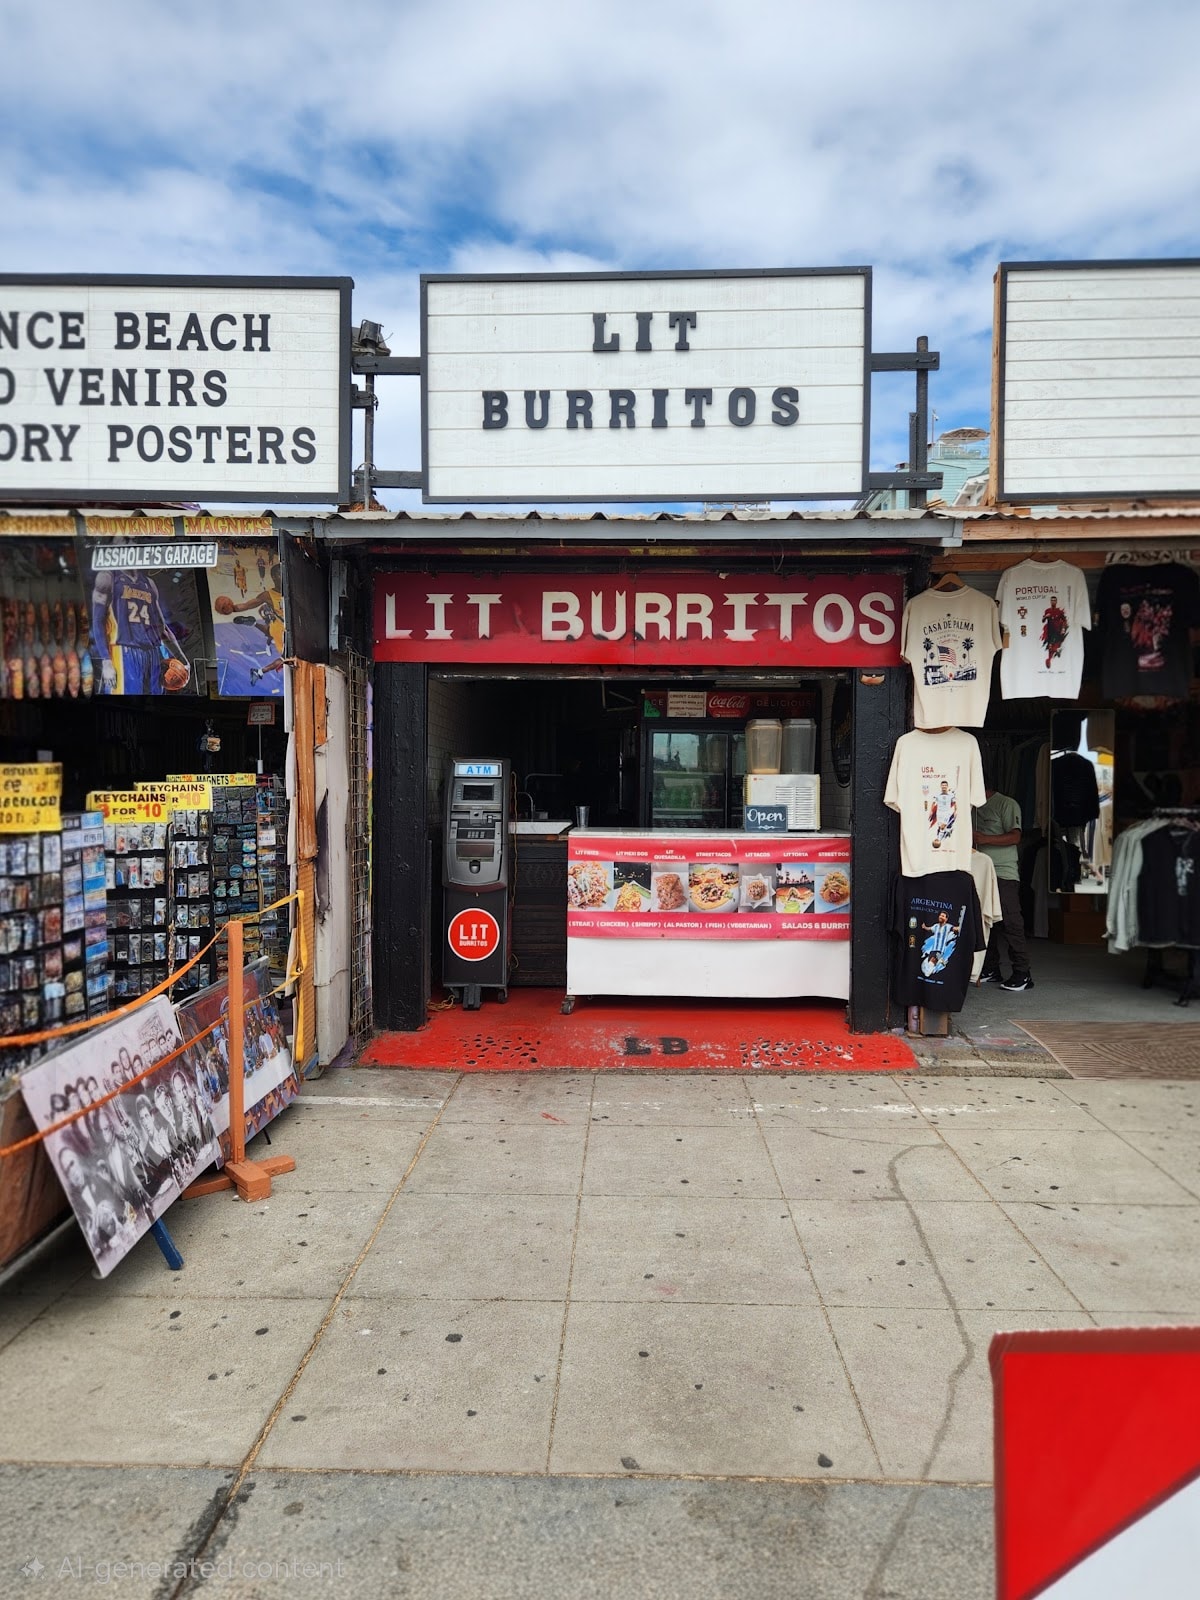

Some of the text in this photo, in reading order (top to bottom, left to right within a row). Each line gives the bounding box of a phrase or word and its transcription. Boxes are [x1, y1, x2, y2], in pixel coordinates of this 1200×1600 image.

[115, 312, 271, 352] BEACH
[592, 312, 697, 352] LIT
[43, 367, 228, 407] VENIRS
[482, 387, 799, 429] BURRITOS
[0, 423, 317, 465] ORY POSTERS
[87, 516, 174, 535] SOUVENIRS
[185, 516, 272, 535] MAGNETS
[96, 544, 214, 567] ASSHOLE'S GARAGE
[1015, 585, 1059, 595] PORTUGAL
[128, 601, 150, 625] 24
[385, 590, 896, 644] LIT BURRITOS
[923, 620, 974, 635] CASA DE PALMA
[466, 765, 491, 774] ATM
[141, 784, 205, 792] KEYCHAINS
[196, 775, 229, 785] MAGNETS
[229, 774, 236, 783] 2
[94, 793, 166, 803] KEYCHAINS
[180, 793, 201, 806] $10
[96, 804, 110, 818] 3
[137, 803, 162, 818] $10
[747, 808, 785, 825] Open
[911, 897, 953, 911] ARGENTINA
[459, 923, 489, 940] LIT
